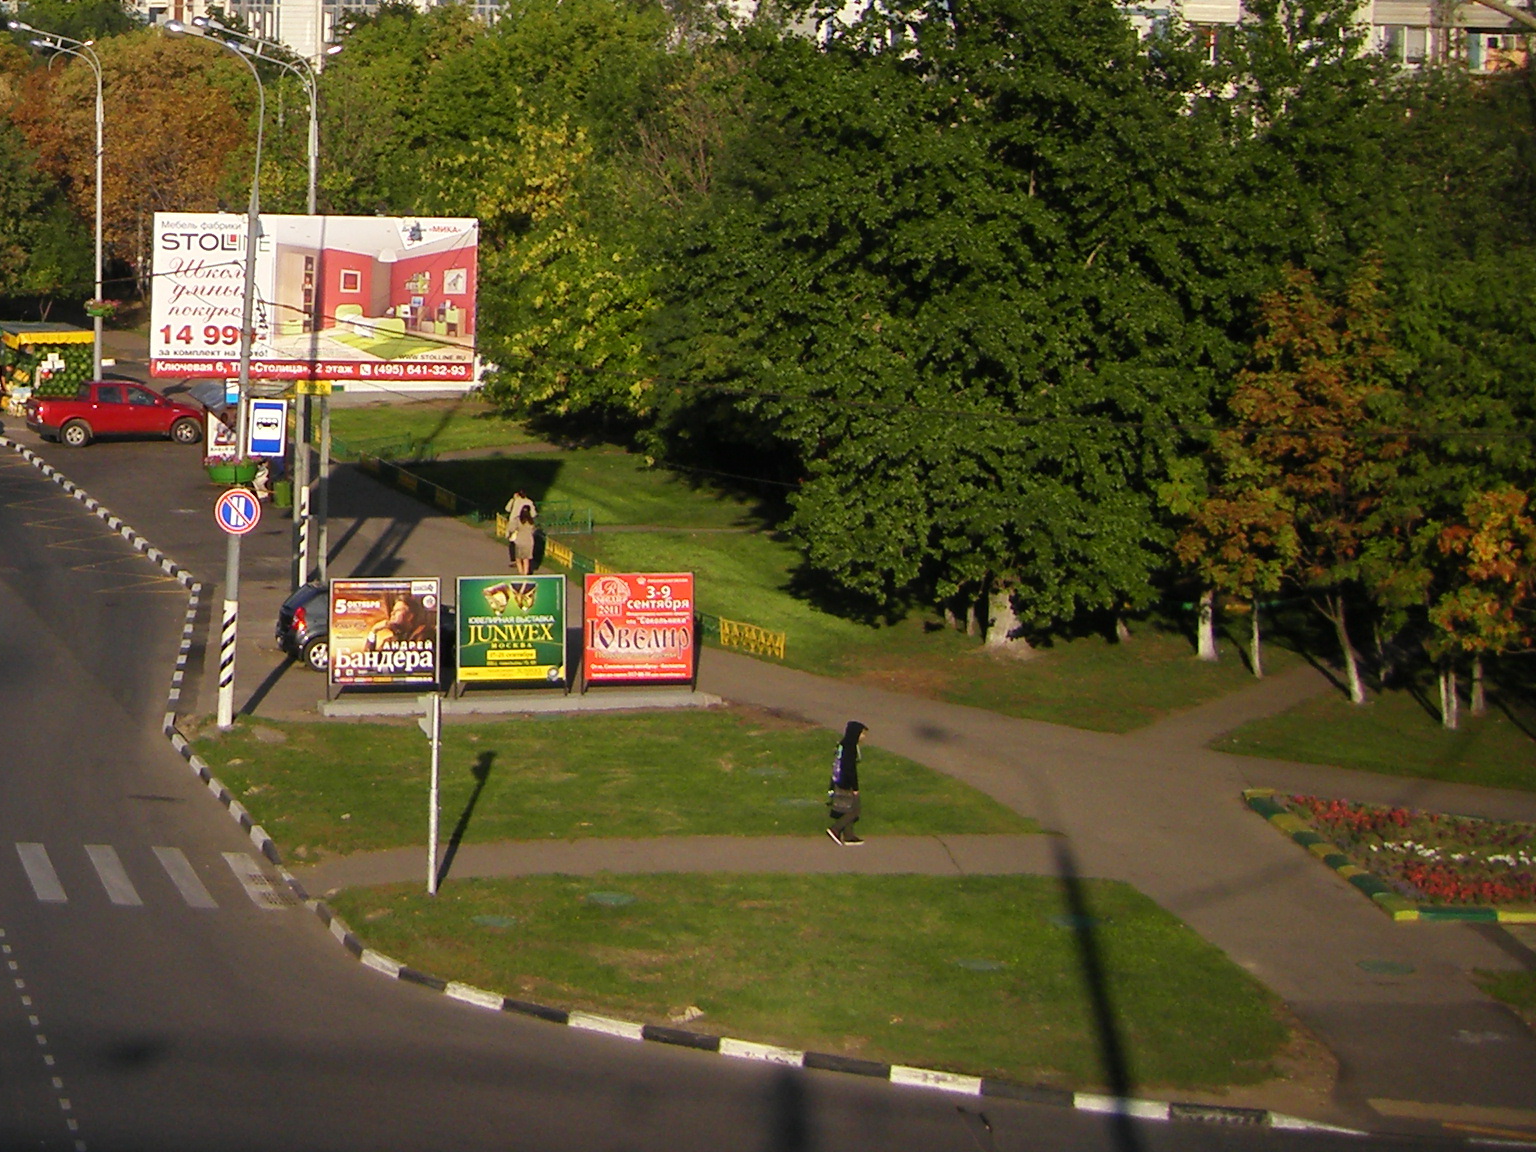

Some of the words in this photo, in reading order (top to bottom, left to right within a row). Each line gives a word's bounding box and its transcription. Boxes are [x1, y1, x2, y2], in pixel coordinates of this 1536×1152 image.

[161, 221, 198, 230] Мебель
[200, 221, 243, 232] фабрики
[168, 256, 246, 279] Школ
[160, 324, 193, 345] 14
[158, 349, 171, 357] за
[173, 349, 222, 358] комплект
[224, 349, 237, 357] на
[156, 361, 215, 372] Ключевая
[216, 361, 228, 374] 6,
[315, 363, 323, 373] 2
[325, 364, 354, 375] этаж
[373, 364, 404, 376] (495)
[406, 364, 467, 377] 641-32-93
[645, 585, 672, 599] 3-9
[335, 598, 347, 614] 5
[347, 601, 381, 609] ОКТЯБРЯ
[626, 596, 691, 611] сентября
[468, 616, 515, 625] ЮВЕЛИРНАЯ
[515, 614, 556, 624] ВЫСТАВКА
[467, 623, 554, 646] JUNWEX
[383, 640, 434, 651] АНДРЕЙ
[490, 641, 534, 649] МОСКВА
[335, 647, 434, 673] Бандера
